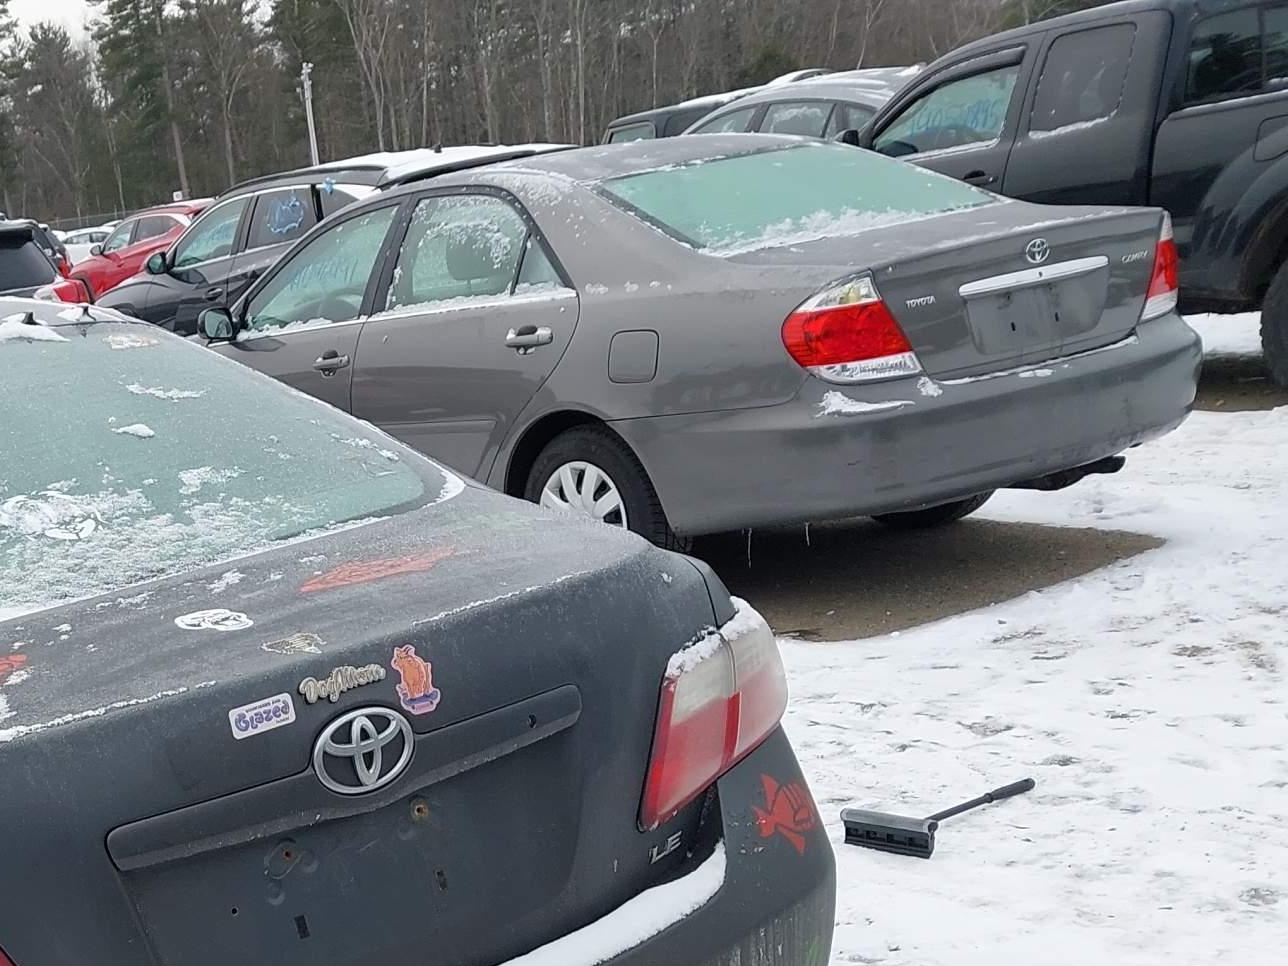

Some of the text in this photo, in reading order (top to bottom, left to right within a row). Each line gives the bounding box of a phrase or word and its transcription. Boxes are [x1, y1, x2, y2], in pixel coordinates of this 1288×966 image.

[905, 295, 937, 310] TOYOTA
[235, 699, 290, 732] Glazed
[648, 831, 682, 864] LE
